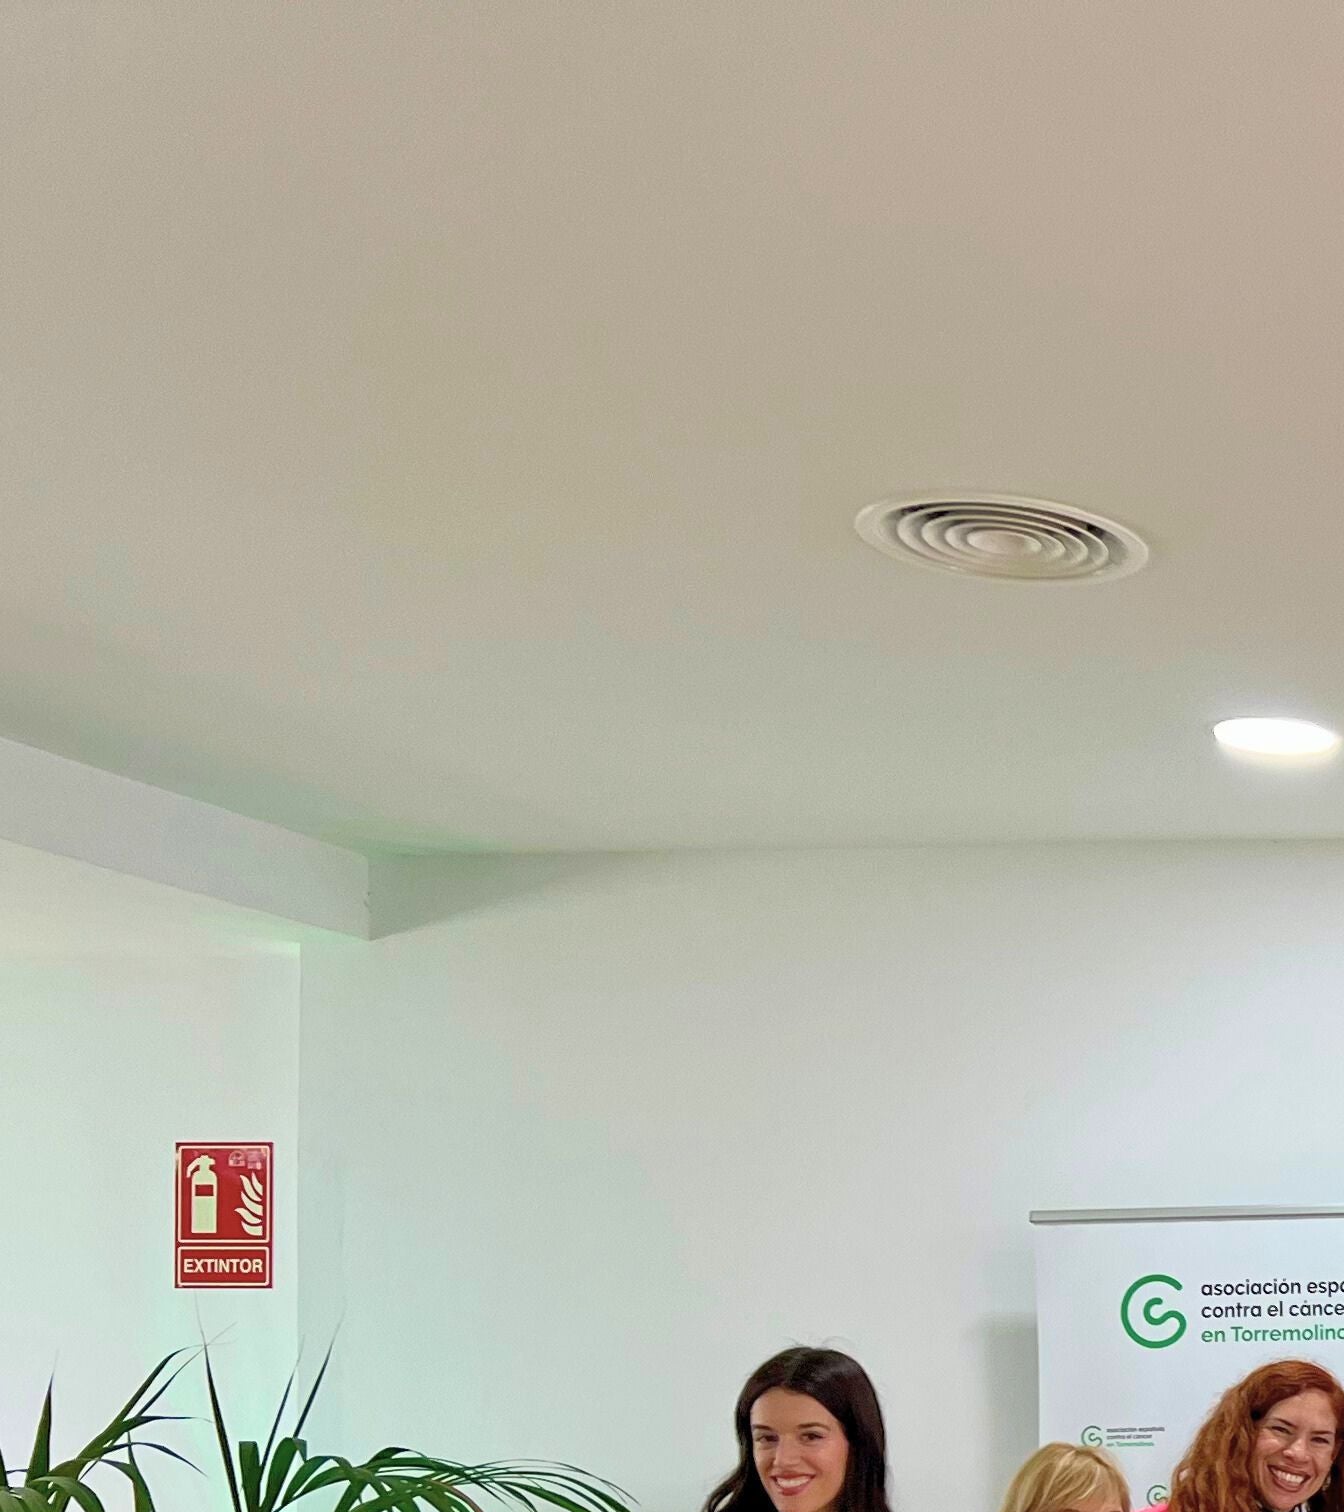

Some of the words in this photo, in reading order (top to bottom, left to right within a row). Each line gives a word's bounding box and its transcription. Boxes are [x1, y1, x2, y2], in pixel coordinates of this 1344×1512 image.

[183, 1258, 263, 1274] EXTINTOR
[1201, 1278, 1301, 1296] asociación
[1201, 1302, 1262, 1318] contra
[1267, 1301, 1283, 1317] el
[1201, 1329, 1226, 1343] en
